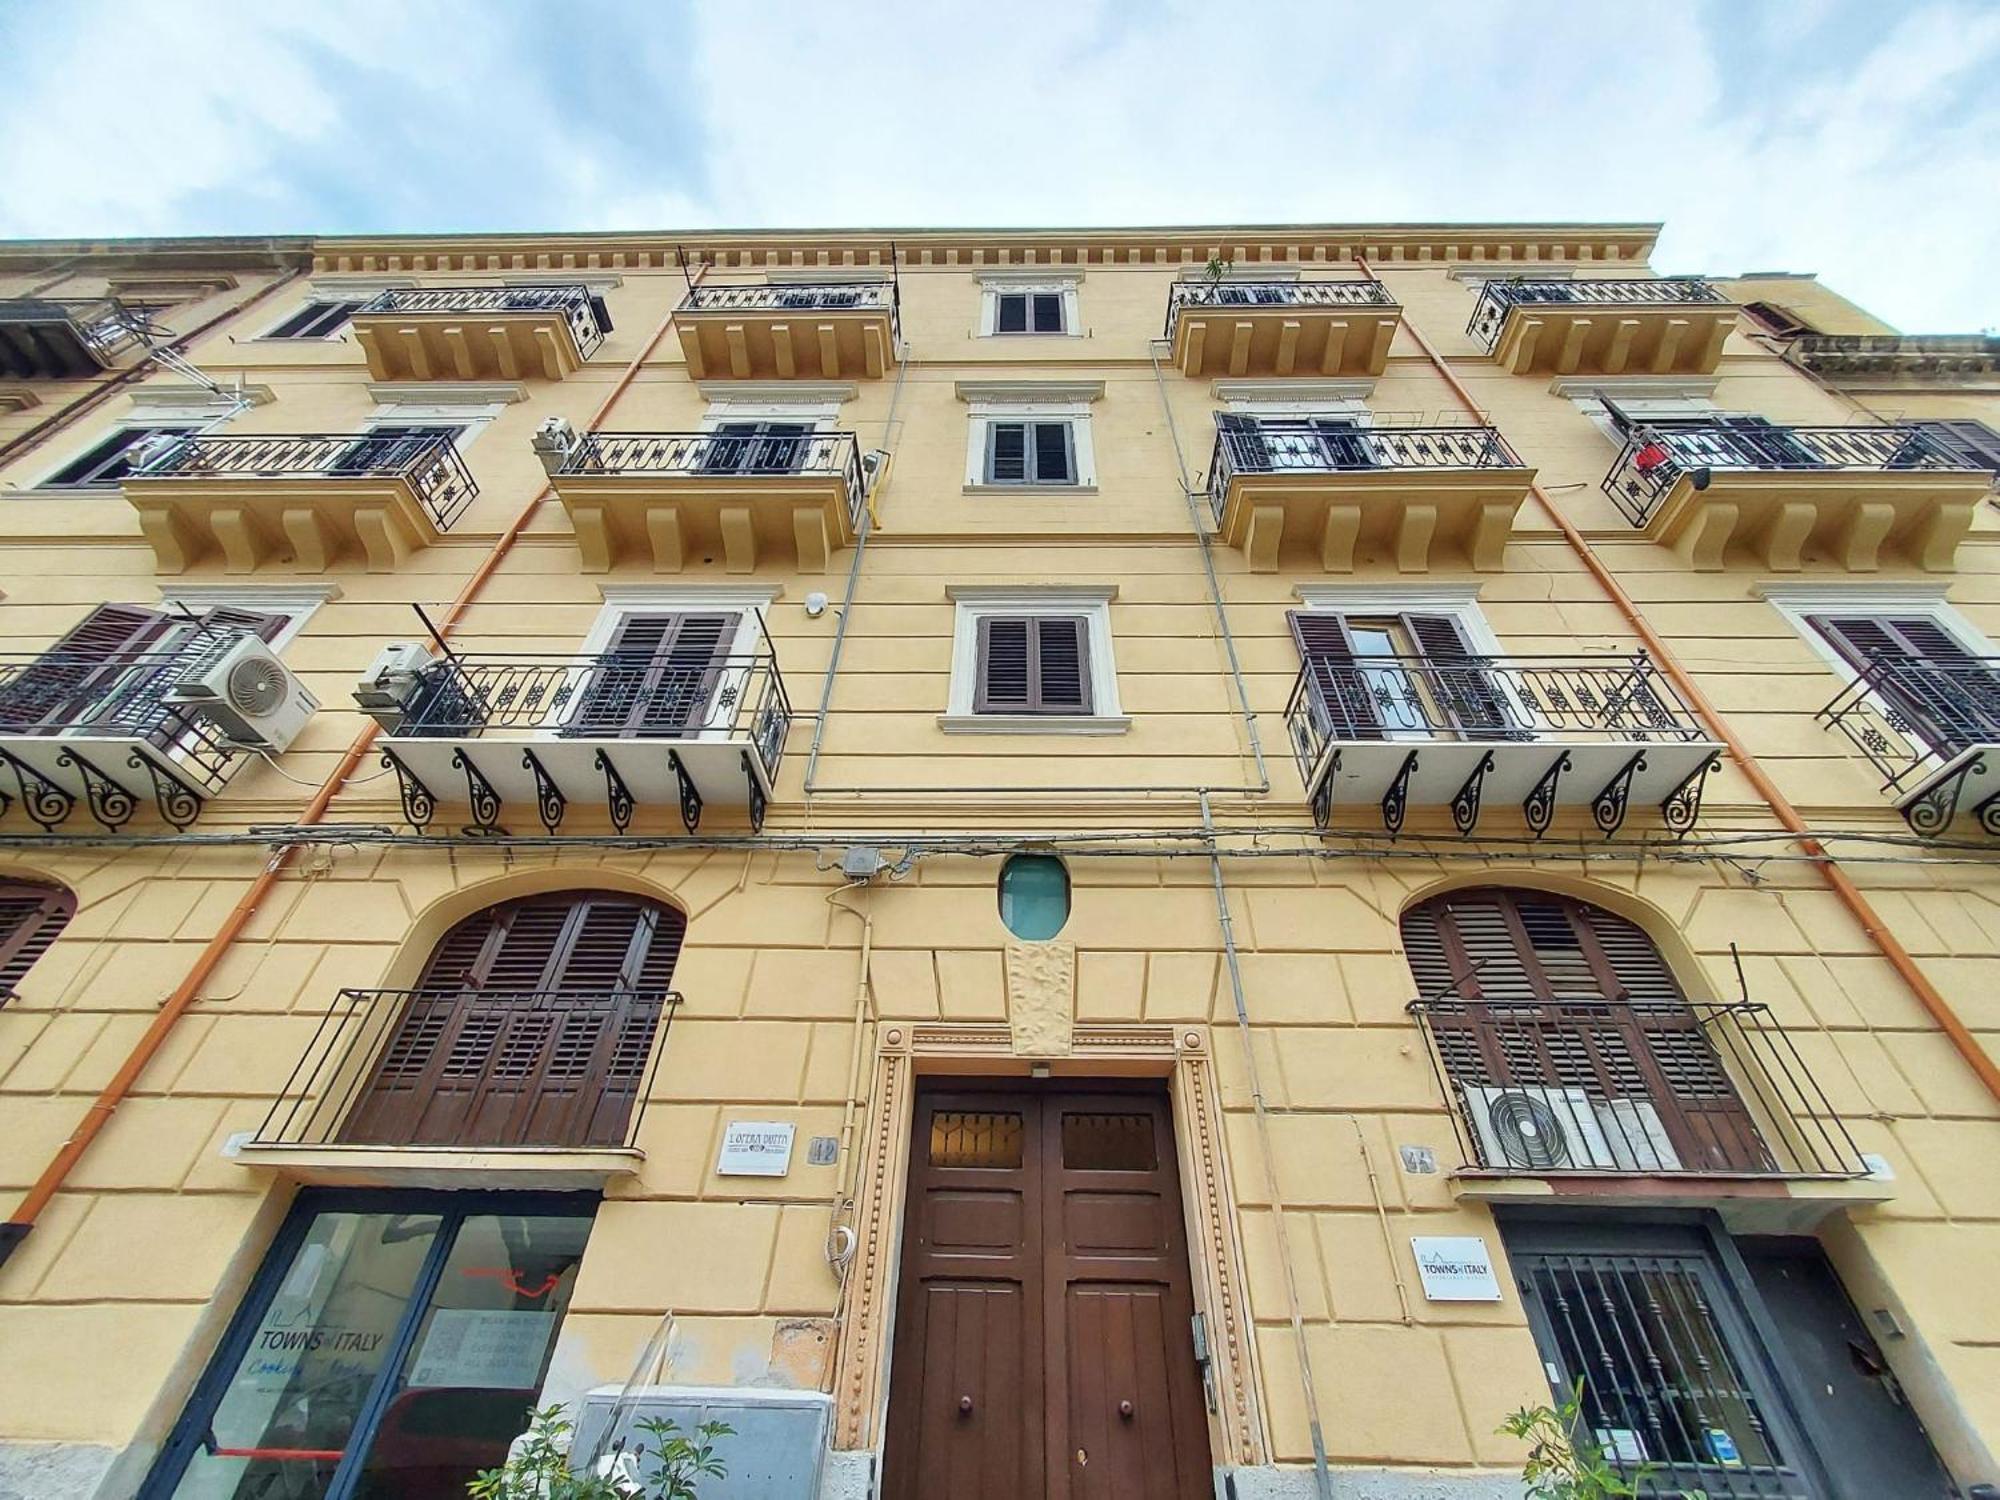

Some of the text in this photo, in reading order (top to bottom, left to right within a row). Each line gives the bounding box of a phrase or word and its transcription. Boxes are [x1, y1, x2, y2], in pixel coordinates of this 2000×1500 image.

[1424, 1264, 1458, 1275] TOWNS
[1463, 1264, 1488, 1275] ITALY
[260, 1331, 325, 1351] TOWNS
[334, 1331, 384, 1352] ITALY
